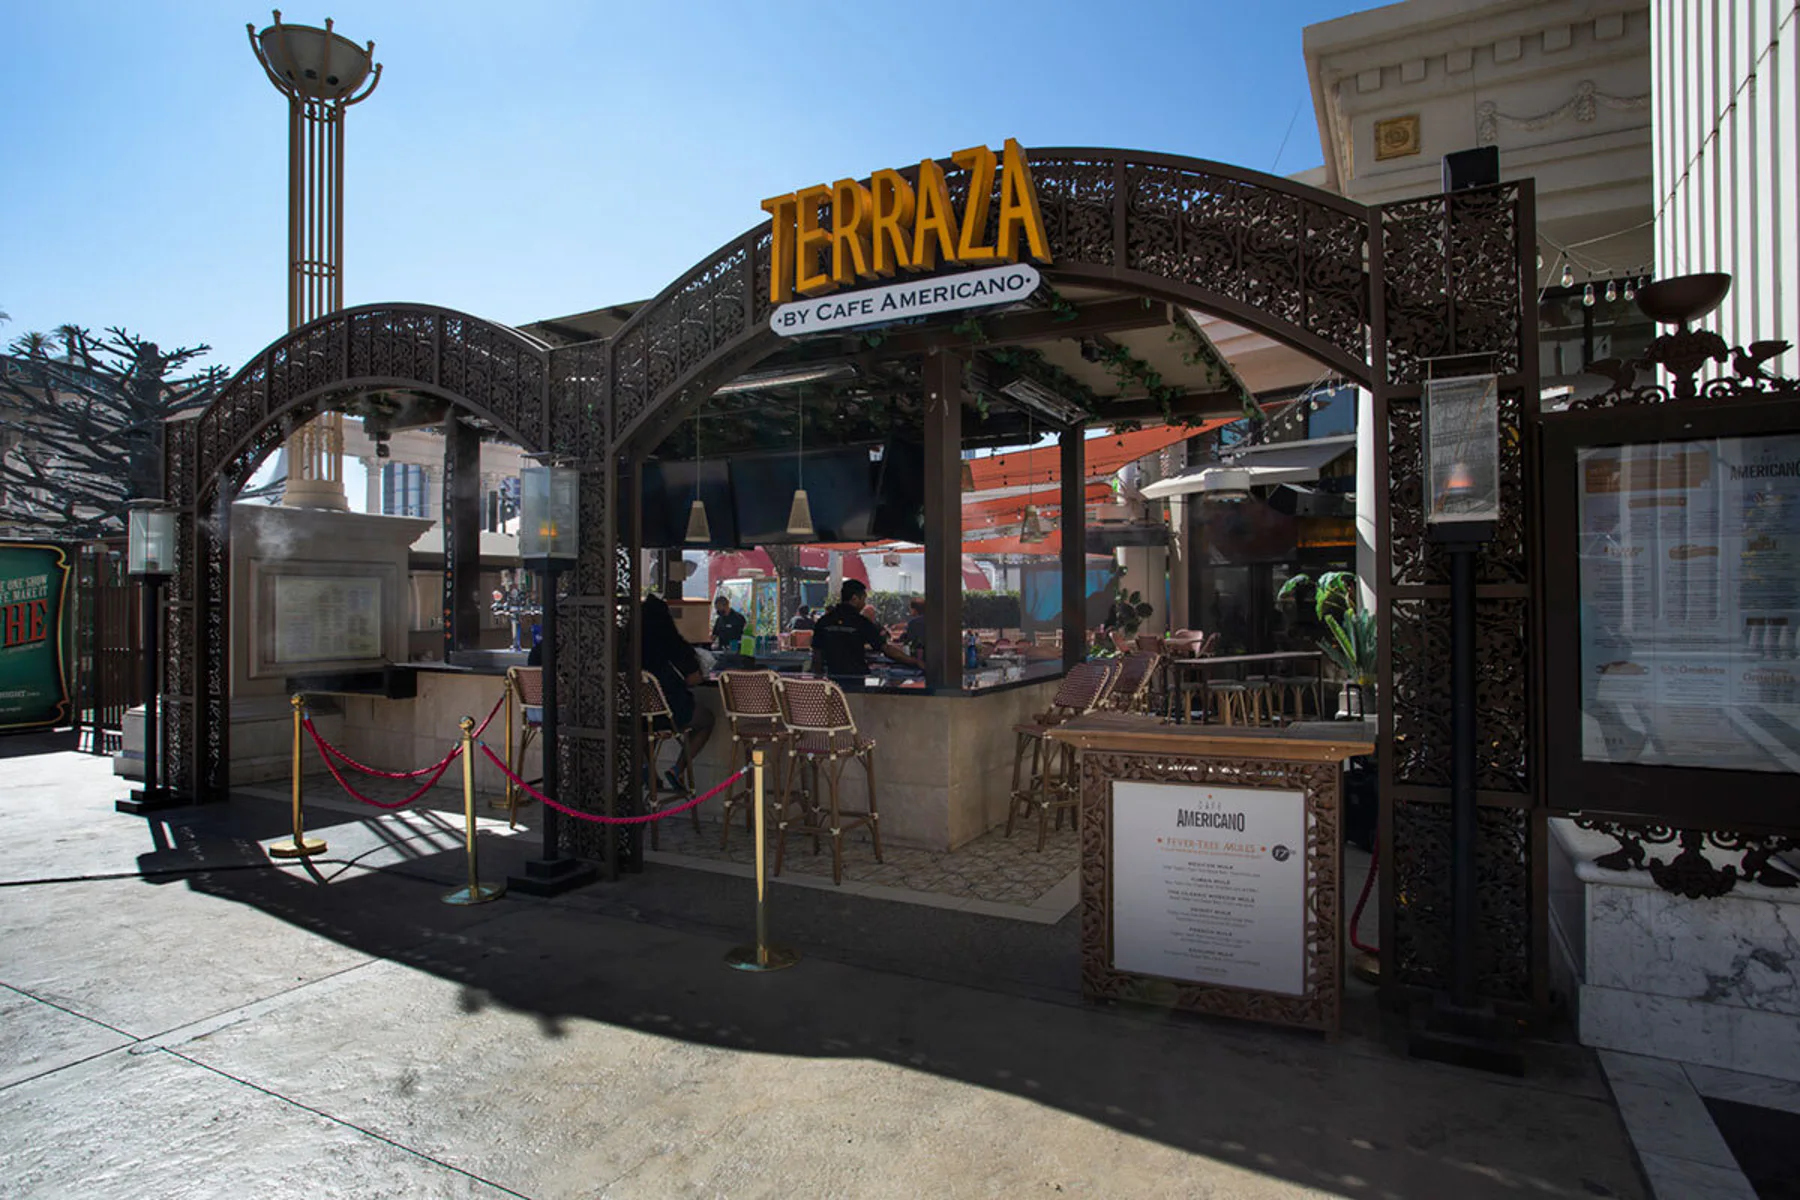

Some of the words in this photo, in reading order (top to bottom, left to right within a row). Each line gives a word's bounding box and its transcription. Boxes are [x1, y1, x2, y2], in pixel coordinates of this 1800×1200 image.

[761, 137, 1053, 304] TERRAZA
[783, 308, 810, 327] BY
[816, 298, 873, 322] CAFE
[880, 273, 1025, 312] AMERICANO
[0, 598, 48, 648] HE
[1176, 808, 1245, 832] AMERICANO
